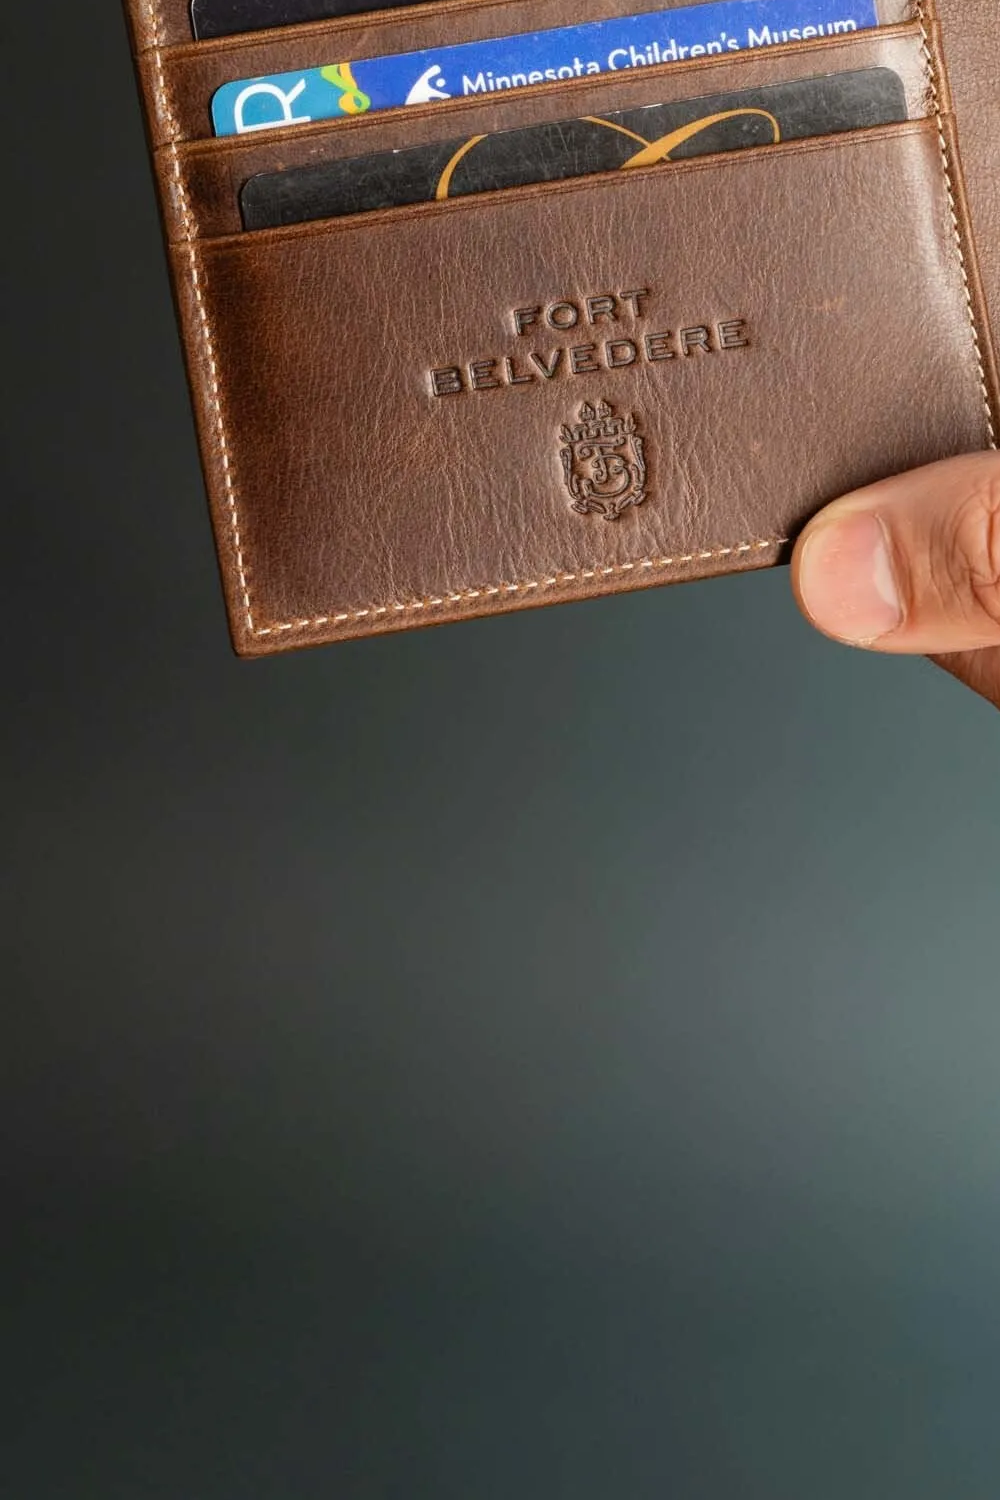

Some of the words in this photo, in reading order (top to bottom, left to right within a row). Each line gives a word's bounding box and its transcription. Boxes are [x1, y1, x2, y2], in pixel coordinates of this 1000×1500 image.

[461, 55, 600, 96] Minnesota
[607, 31, 740, 72] Children's
[747, 18, 858, 48] Museum
[513, 287, 651, 337] FORT
[428, 318, 750, 397] BELVEDERE
